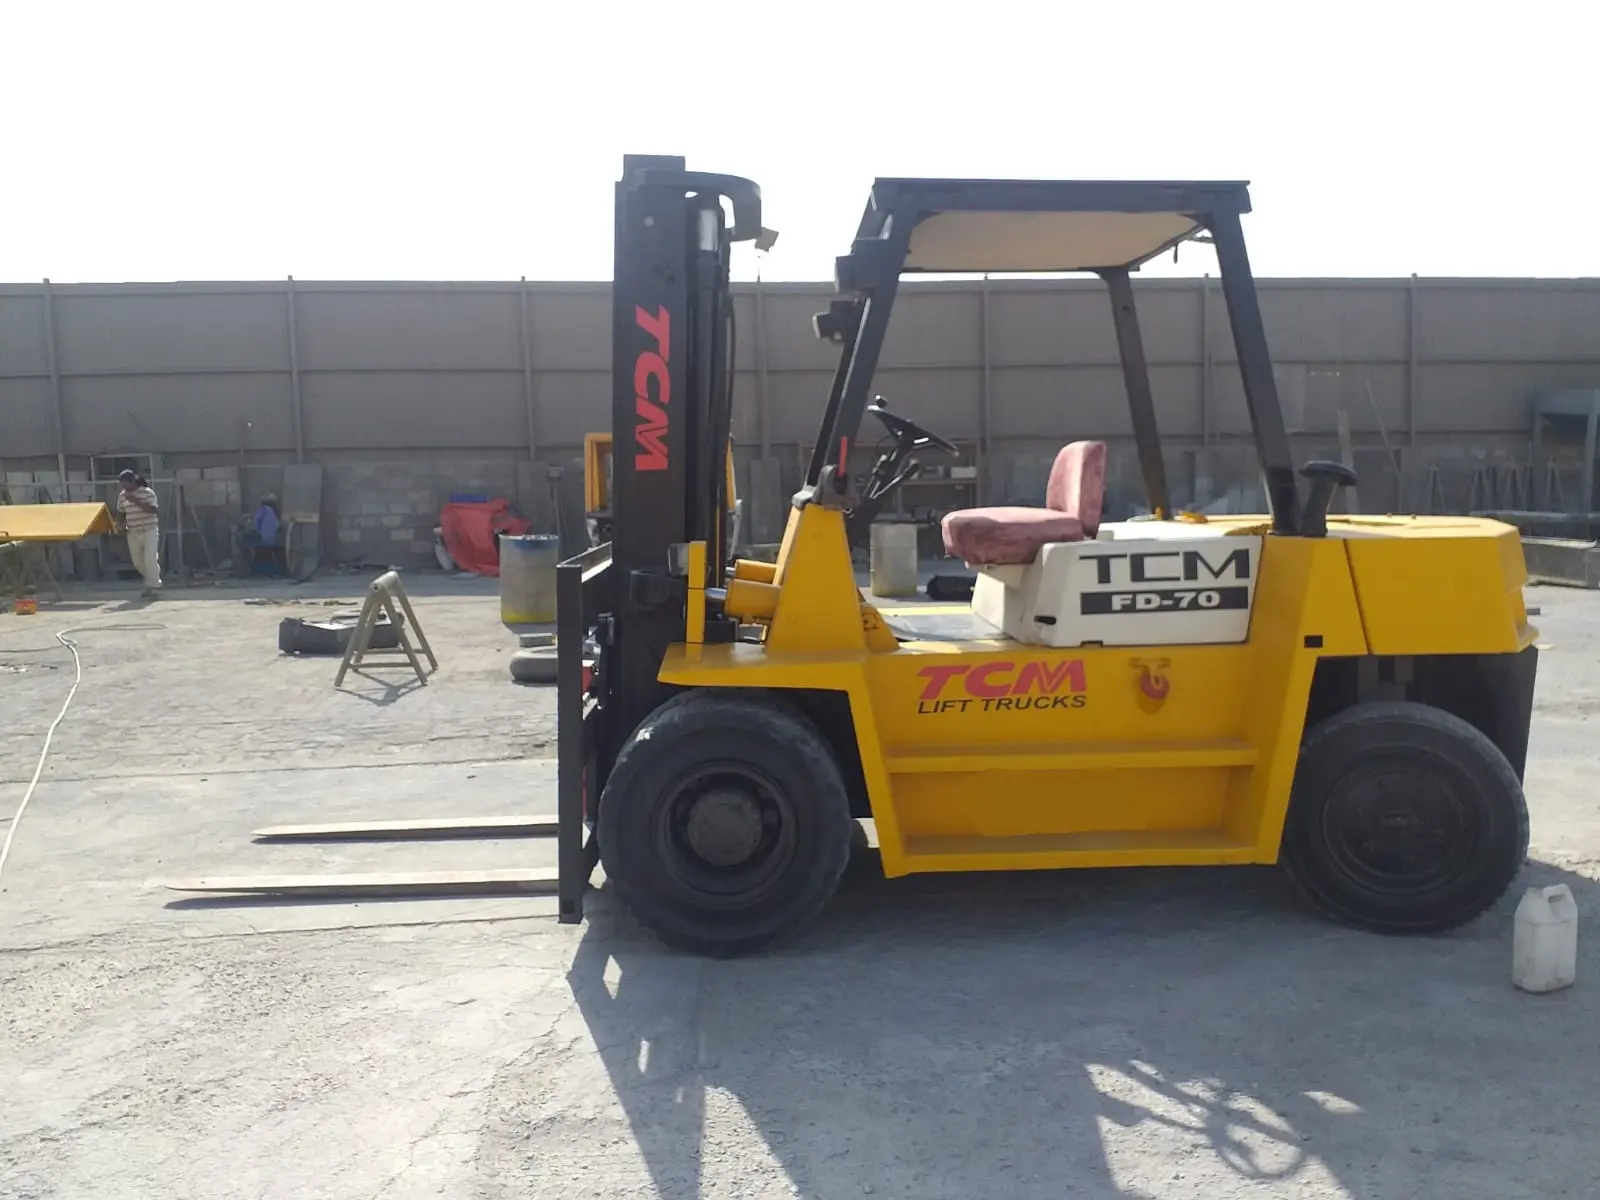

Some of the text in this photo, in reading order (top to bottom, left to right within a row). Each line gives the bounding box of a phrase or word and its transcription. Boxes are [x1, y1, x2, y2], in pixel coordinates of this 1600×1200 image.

[634, 304, 671, 471] TCM
[1079, 549, 1250, 584] TCM
[1111, 590, 1220, 611] FD-70
[916, 659, 1087, 700] TCM
[917, 694, 1087, 714] LIFT TRUCKS
